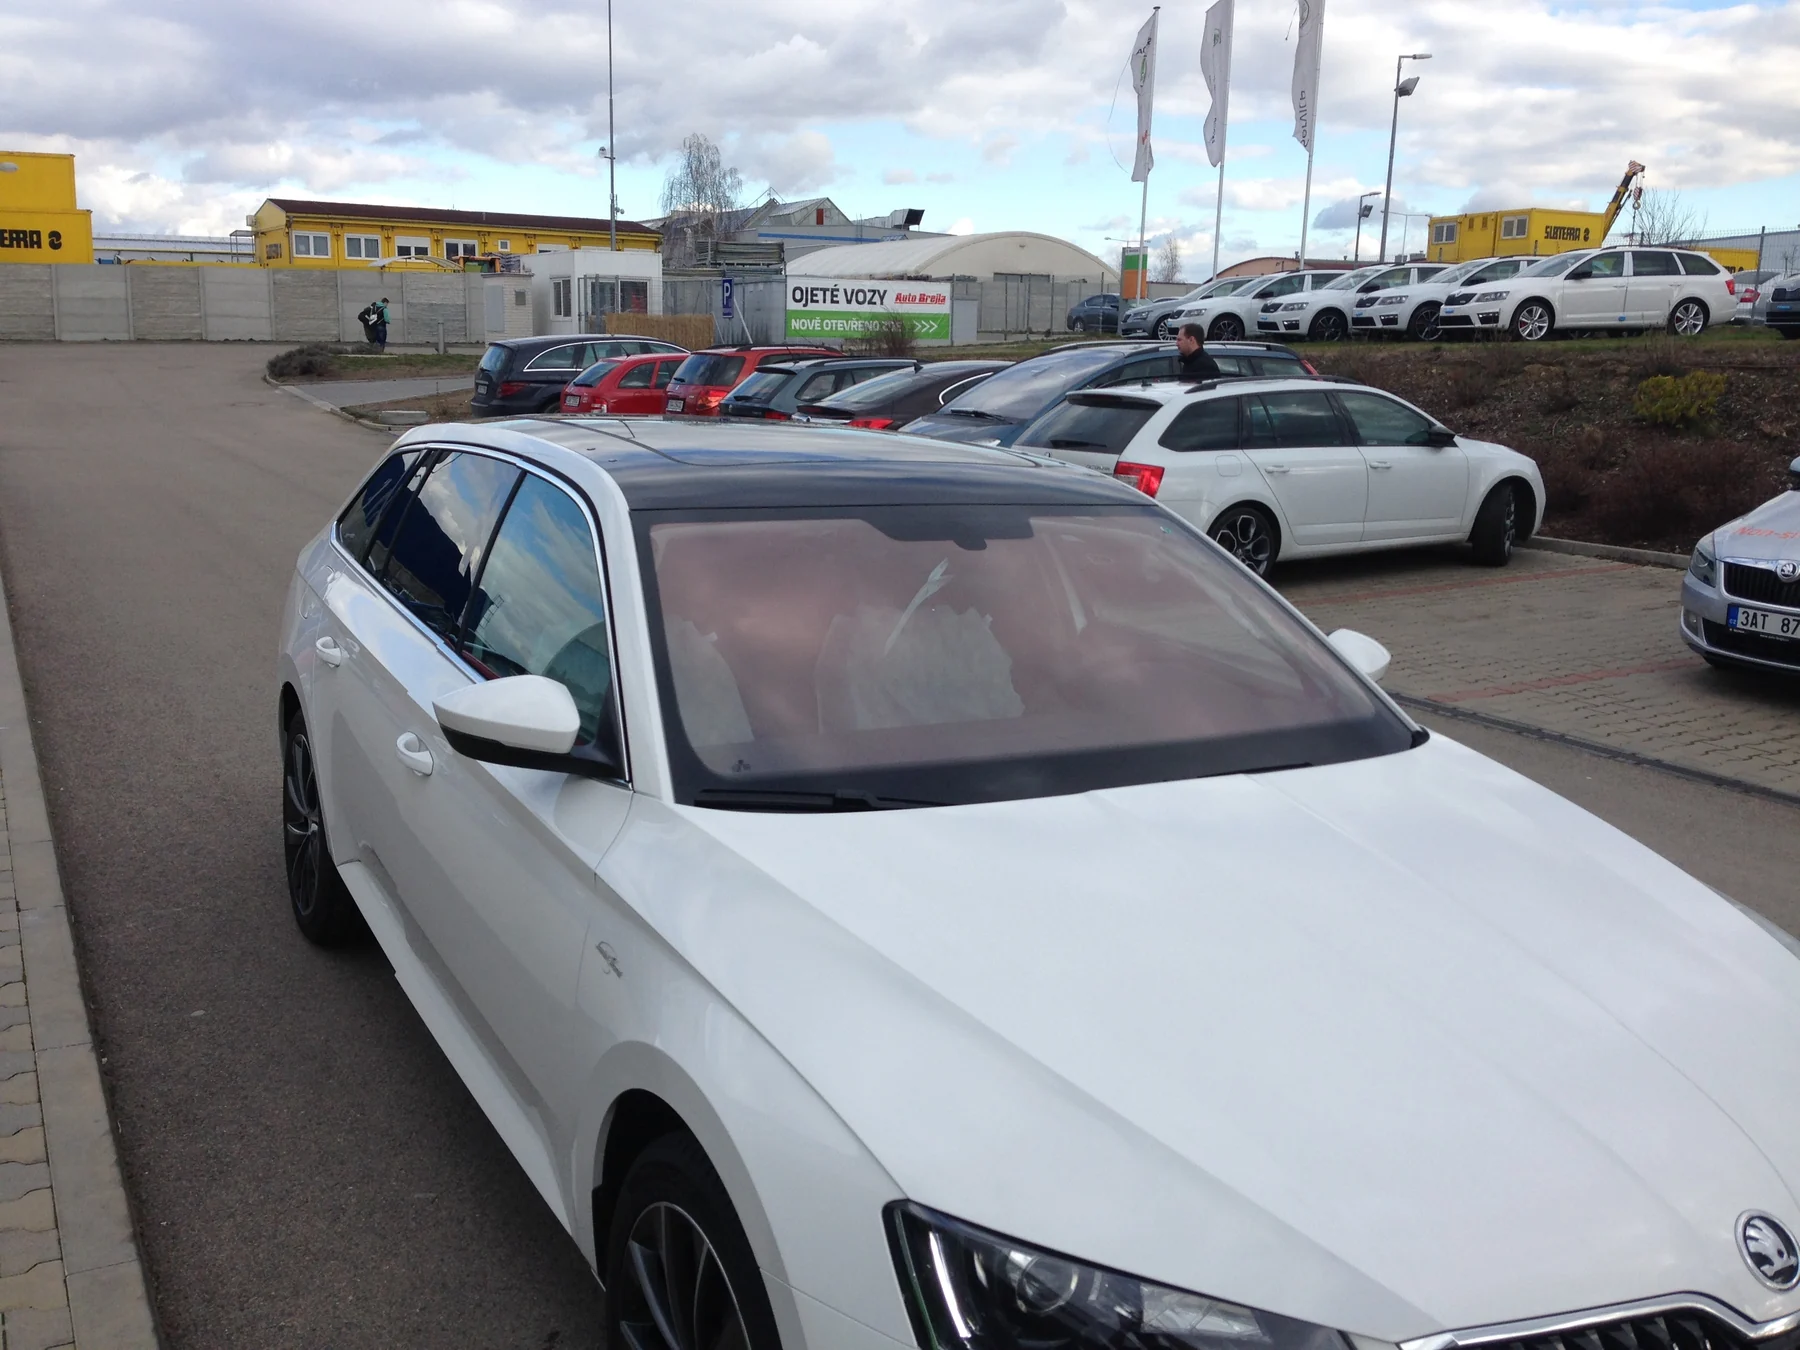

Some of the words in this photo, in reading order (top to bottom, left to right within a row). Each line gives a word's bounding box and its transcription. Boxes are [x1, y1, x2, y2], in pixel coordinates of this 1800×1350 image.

[724, 282, 731, 306] P
[792, 283, 840, 308] OJETÉ
[844, 288, 888, 306] VOZY
[894, 292, 917, 304] Auto
[918, 293, 946, 305] Brejla
[791, 316, 821, 331] NOVĚ
[823, 317, 880, 333] OTEVŘENO
[1740, 610, 1769, 630] 3AT
[1780, 617, 1800, 635] 87
